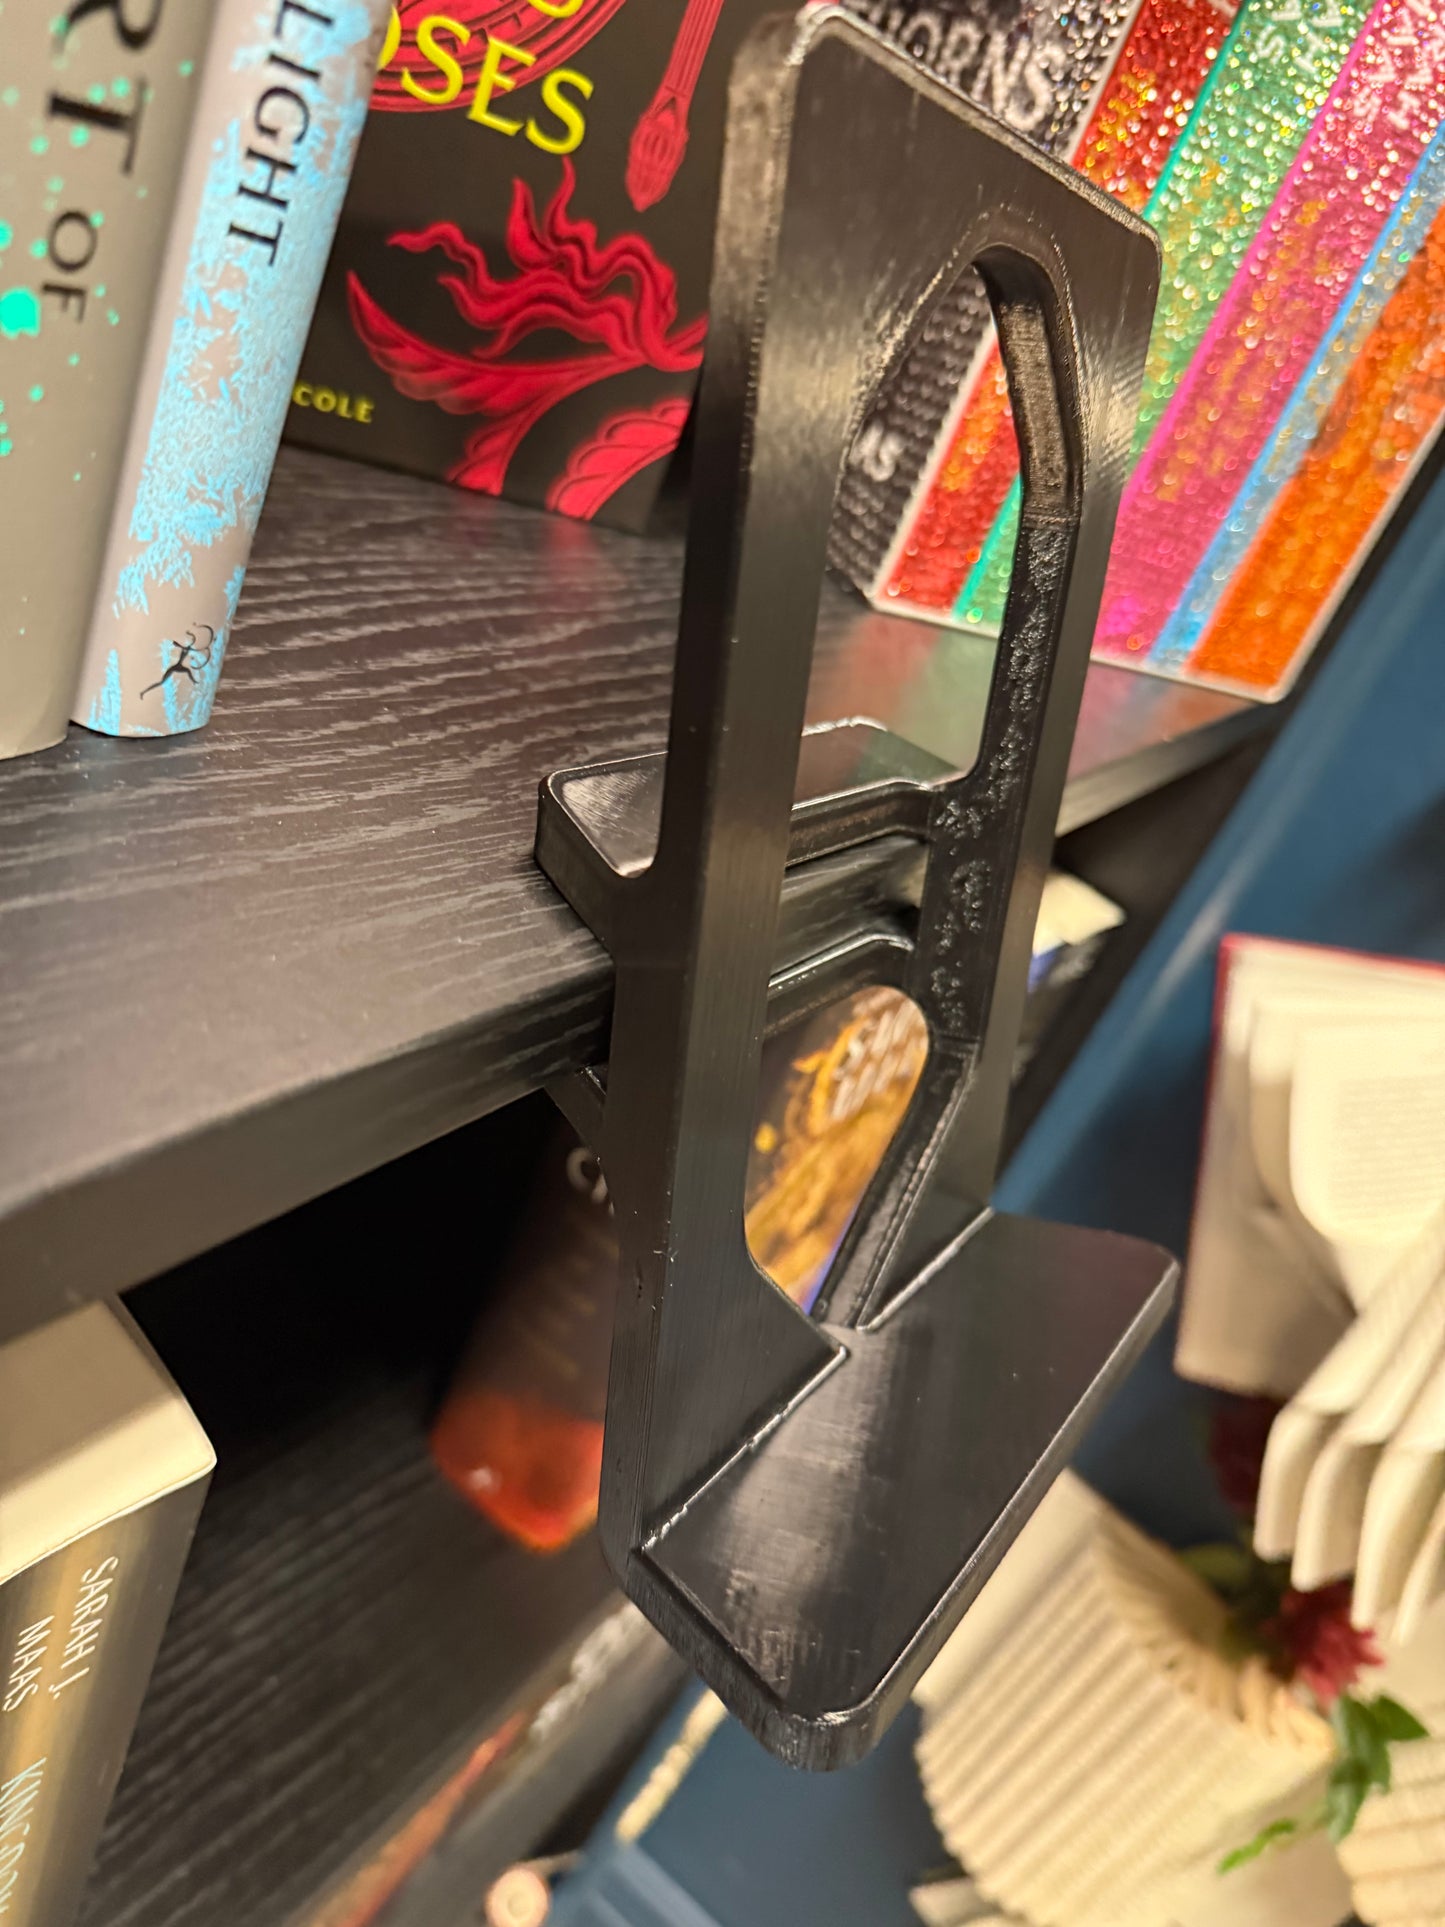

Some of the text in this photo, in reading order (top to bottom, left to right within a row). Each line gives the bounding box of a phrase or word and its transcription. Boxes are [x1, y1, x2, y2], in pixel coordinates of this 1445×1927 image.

[228, 0, 334, 266] LIGHT
[377, 5, 594, 155] SES
[42, 210, 98, 323] OF
[293, 383, 375, 423] COLE
[2, 1615, 55, 1712] MAAS
[48, 1556, 119, 1700] SARAH J.
